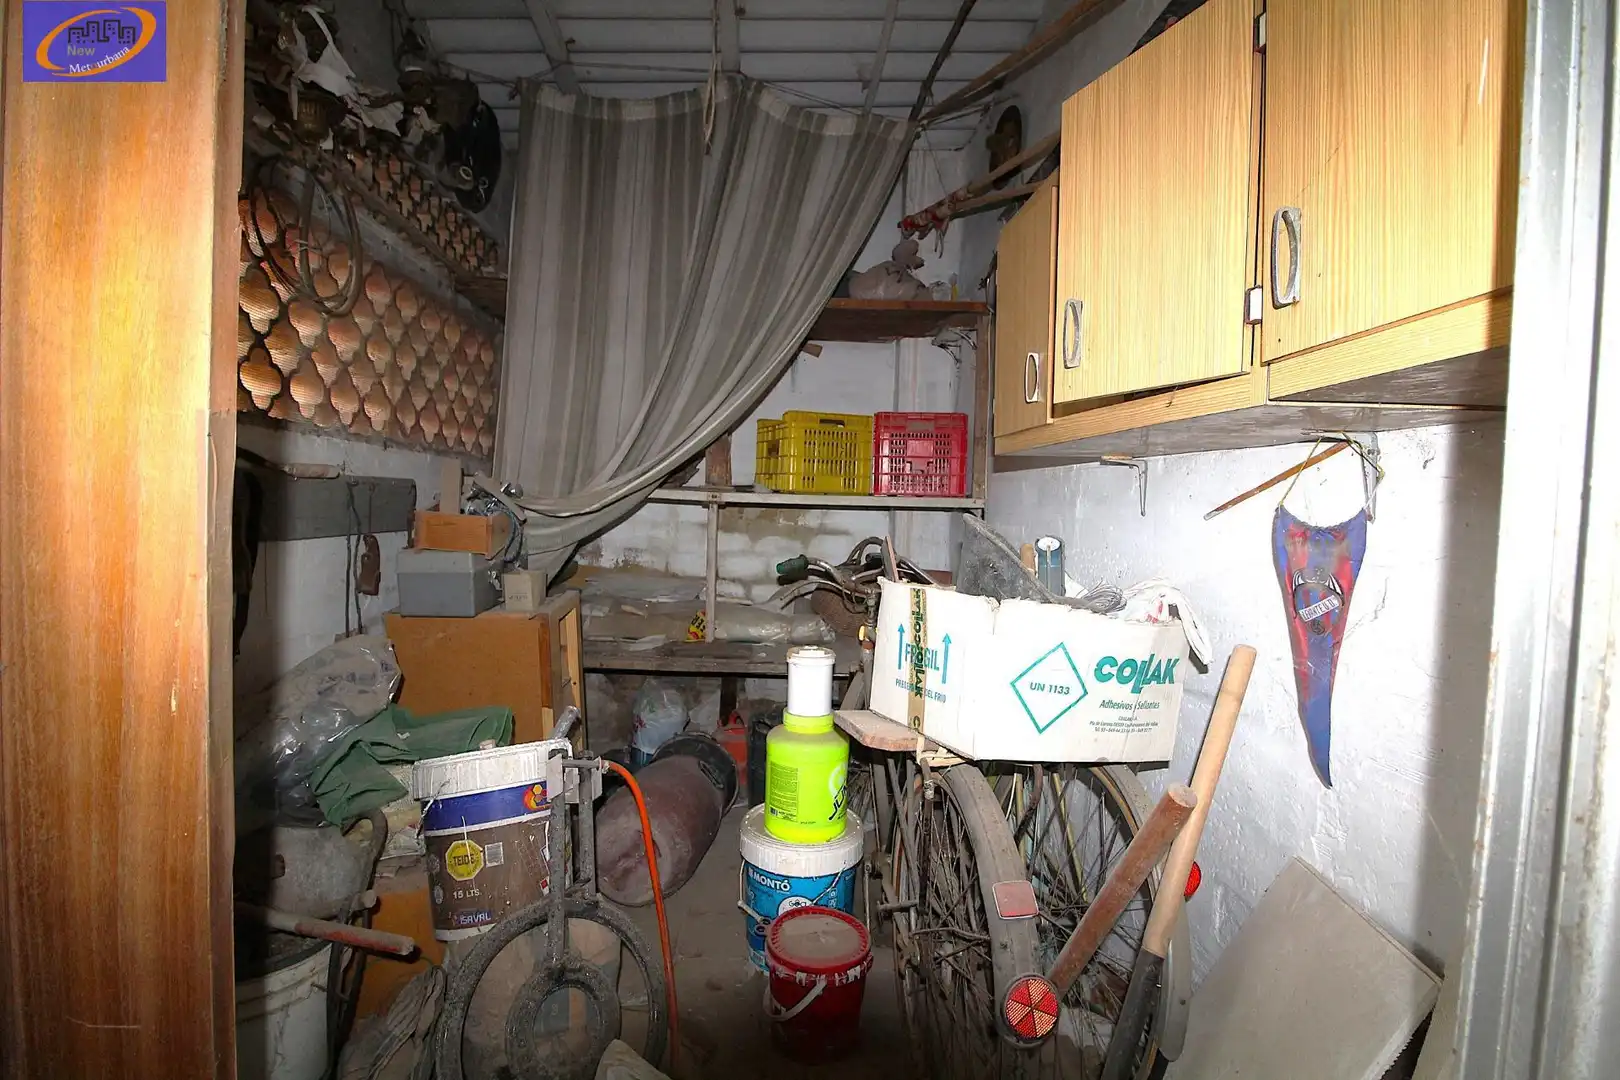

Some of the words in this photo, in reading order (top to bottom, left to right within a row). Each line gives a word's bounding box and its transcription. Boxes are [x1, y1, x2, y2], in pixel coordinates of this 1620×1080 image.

[904, 643, 940, 671] FRGIL
[1094, 653, 1180, 694] COLLAK
[1029, 682, 1046, 692] UN
[1049, 685, 1071, 695] 1133
[1099, 700, 1133, 710] Adhesivos
[753, 873, 790, 891] MONTÓ
[453, 890, 464, 899] 15
